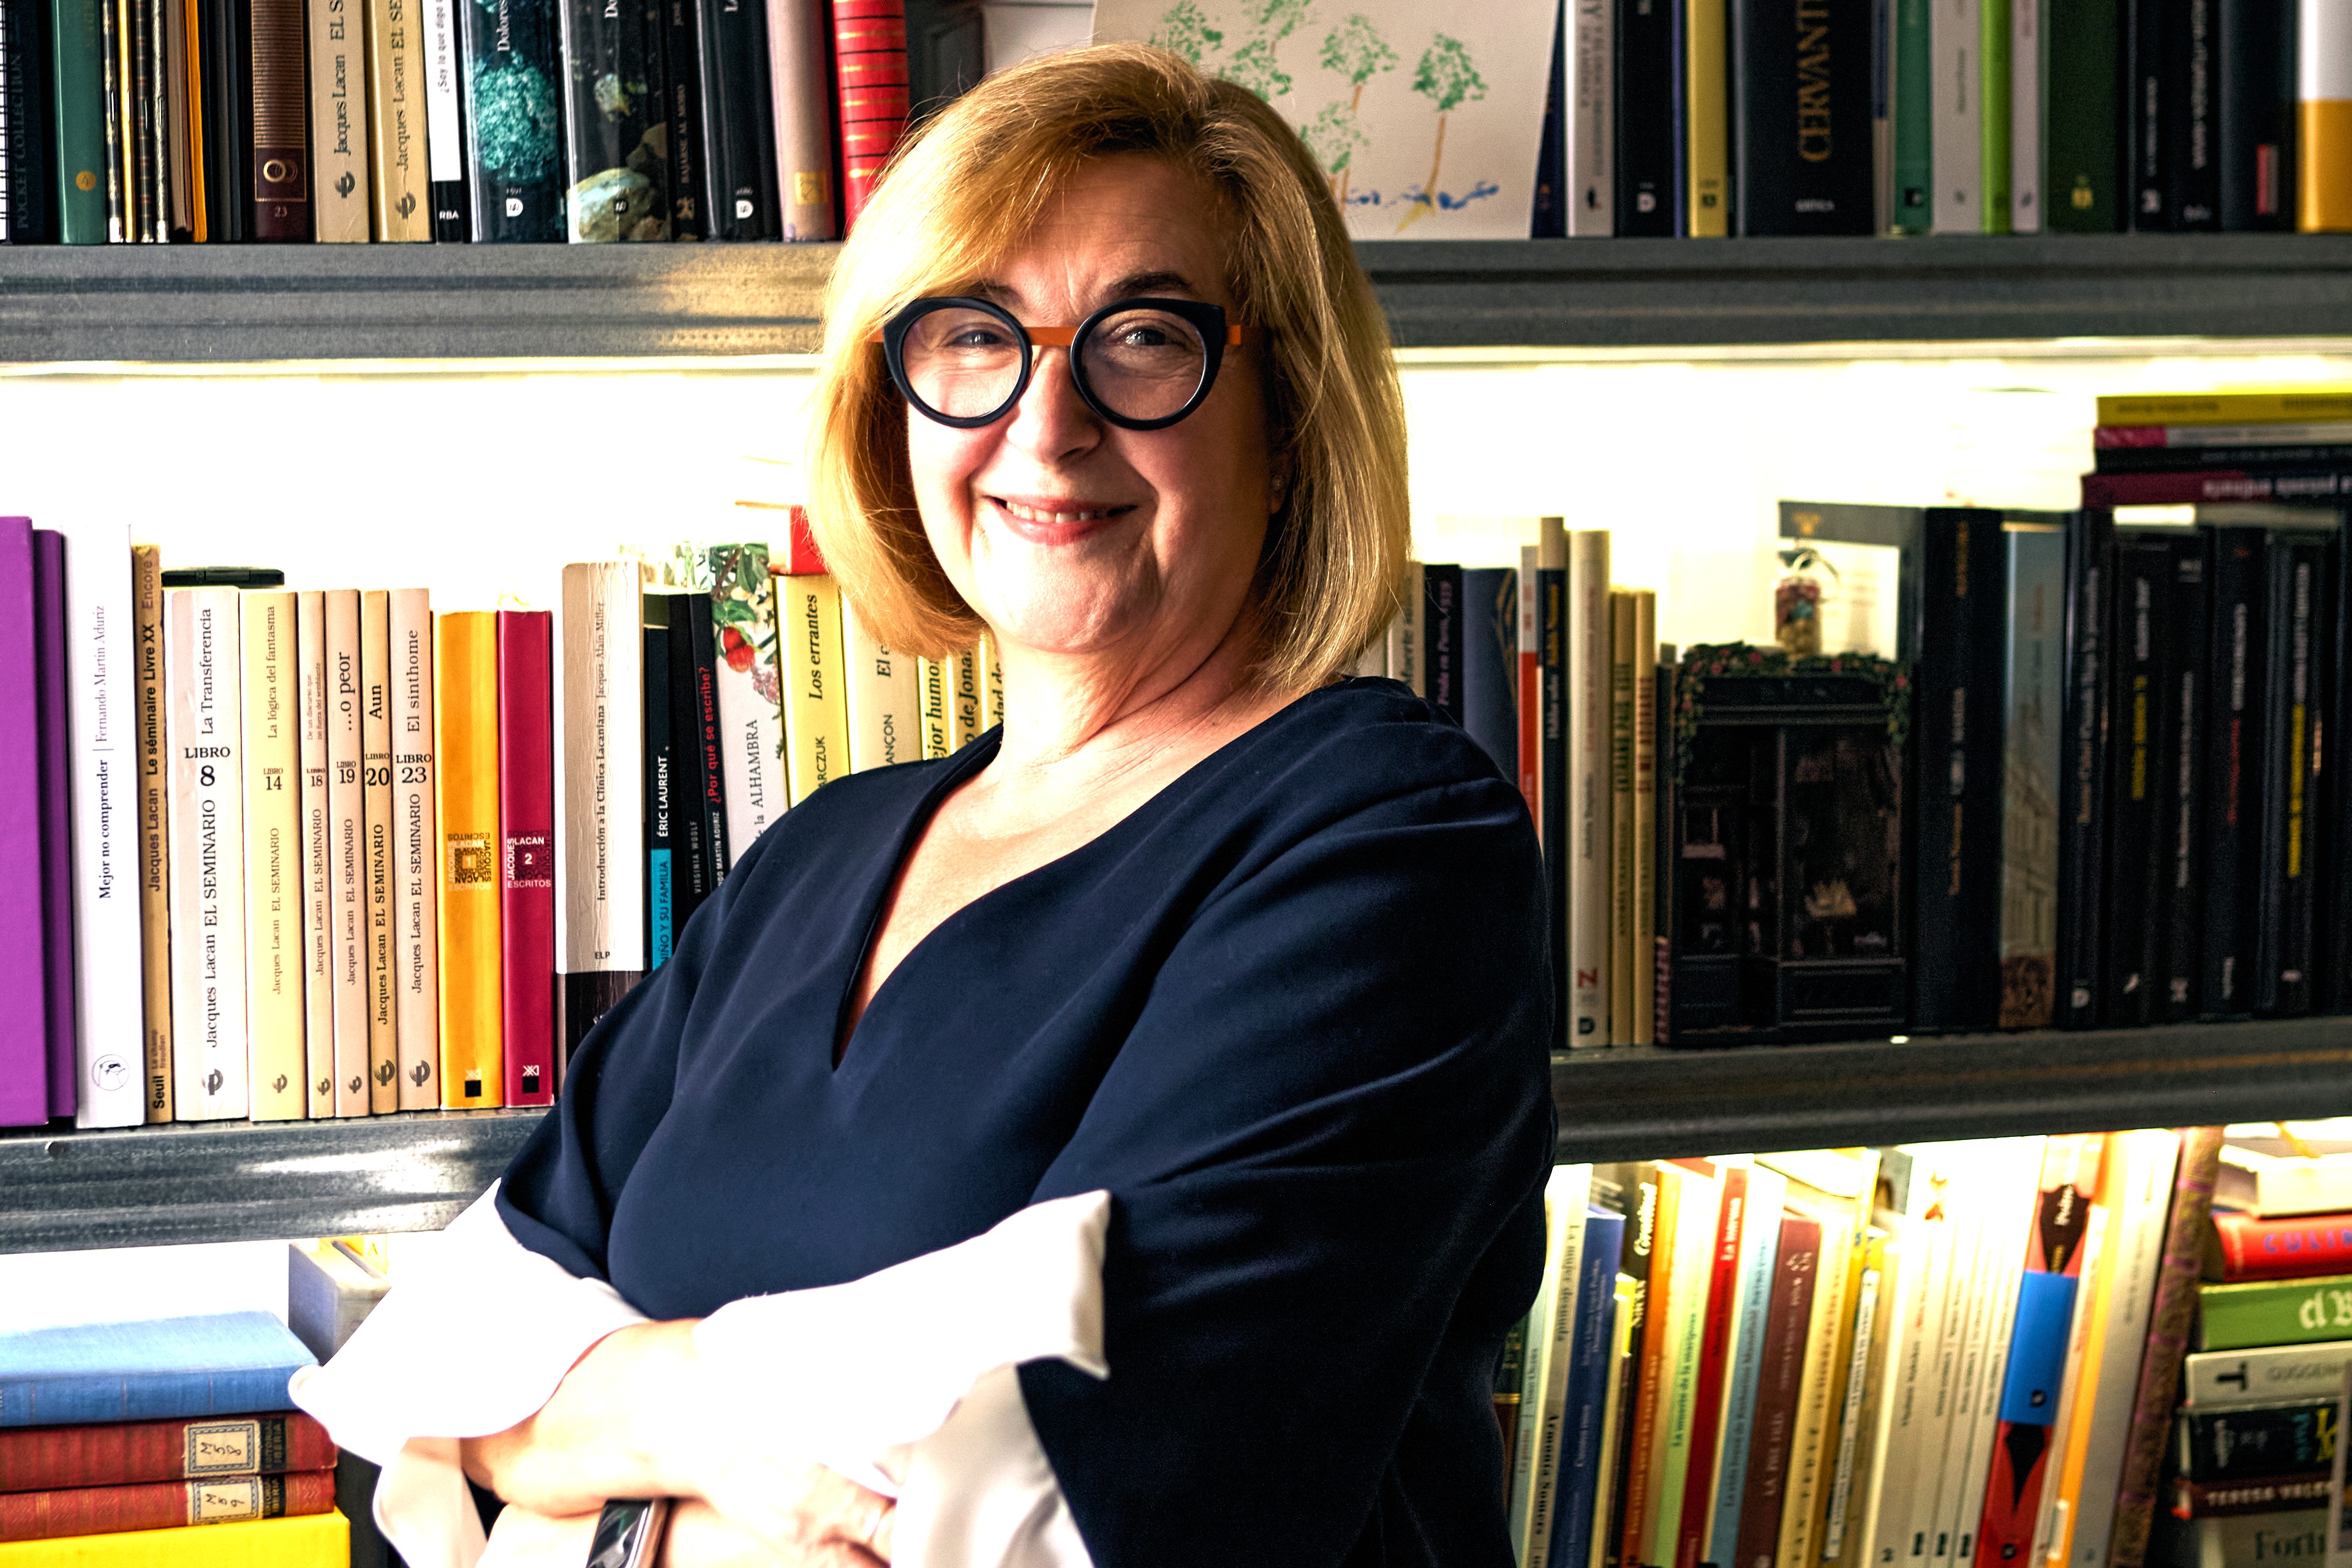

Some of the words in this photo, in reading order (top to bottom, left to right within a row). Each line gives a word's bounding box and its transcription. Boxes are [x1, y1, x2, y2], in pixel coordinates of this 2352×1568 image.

[330, 15, 344, 41] EL
[391, 28, 405, 50] EL
[332, 54, 346, 99] Lacan
[393, 56, 405, 103] Lacan
[334, 102, 351, 156] Jacques
[396, 110, 410, 172] Jacques
[141, 560, 154, 610] Encore
[93, 605, 105, 644] Aduriz
[142, 624, 154, 643] XX
[265, 606, 276, 662] fantasma
[805, 594, 821, 665] errantes
[94, 647, 106, 685] Martín
[143, 647, 156, 681] Livre
[200, 608, 213, 713] Transferencia
[265, 665, 276, 683] del
[338, 652, 356, 695] peor
[406, 630, 419, 709] sinthome
[875, 658, 892, 677] El
[698, 666, 714, 722] escribe?
[808, 669, 823, 700] Los
[95, 690, 107, 742] Fernando
[266, 687, 279, 720] lógica
[369, 684, 382, 720] Aun
[959, 704, 975, 728] de
[145, 687, 157, 755] séminaire
[202, 717, 213, 734] La
[266, 724, 277, 739] La
[407, 715, 420, 733] El
[596, 705, 605, 760] Lacaniana
[704, 725, 715, 741] se
[146, 759, 158, 775] Le
[185, 747, 230, 759] LIBRO
[396, 753, 432, 764] LIBRO
[703, 744, 719, 770] qué
[745, 719, 763, 808] ALHAMBRA
[200, 766, 215, 786] 8
[265, 775, 282, 791] 14
[311, 775, 323, 787] 18
[339, 768, 355, 784] 19
[366, 767, 390, 786] 20
[401, 766, 427, 783] 23
[596, 763, 605, 802] Clínica
[657, 755, 668, 809] LAURENT
[707, 774, 722, 804] ¿Por
[96, 760, 112, 838] comprender
[147, 788, 159, 830] Lacan
[597, 805, 605, 815] la
[409, 793, 421, 874] SEMINARIO
[657, 812, 668, 837] ÉRIC
[753, 815, 764, 825] la
[99, 841, 110, 858] no
[202, 799, 217, 900] SEMINARIO
[312, 808, 323, 875] SEMINARIO
[344, 819, 355, 884] SEMINARIO
[514, 837, 545, 845] LACAN
[148, 834, 162, 892] Jacques
[270, 827, 281, 894] SEMINARIO
[373, 824, 385, 905] SEMINARIO
[507, 837, 515, 880] JACQUES
[524, 853, 533, 865] 2
[597, 827, 606, 901] Introducción
[99, 861, 114, 899] Mejor
[314, 877, 323, 893] EL
[345, 887, 355, 903] EL
[411, 878, 421, 896] EL
[508, 880, 551, 889] ESCRITOS
[659, 861, 669, 904] FAMILIA
[203, 905, 217, 927] EL
[271, 897, 281, 911] EL
[314, 900, 323, 931] Lacan
[375, 909, 385, 927] EL
[410, 902, 421, 939] Lacan
[660, 907, 669, 921] SU
[271, 919, 281, 949] Lacan
[345, 910, 355, 941] Lacan
[203, 934, 216, 979] Lacan
[315, 935, 326, 976] Jacques
[347, 945, 358, 986] Jacques
[376, 934, 386, 971] Lacan
[412, 944, 424, 993] Jacques
[594, 951, 610, 960] ELP
[272, 954, 282, 995] Jacques
[377, 974, 390, 1025] Jacques
[205, 987, 221, 1048] Jacques
[151, 1075, 165, 1109] Seuil
